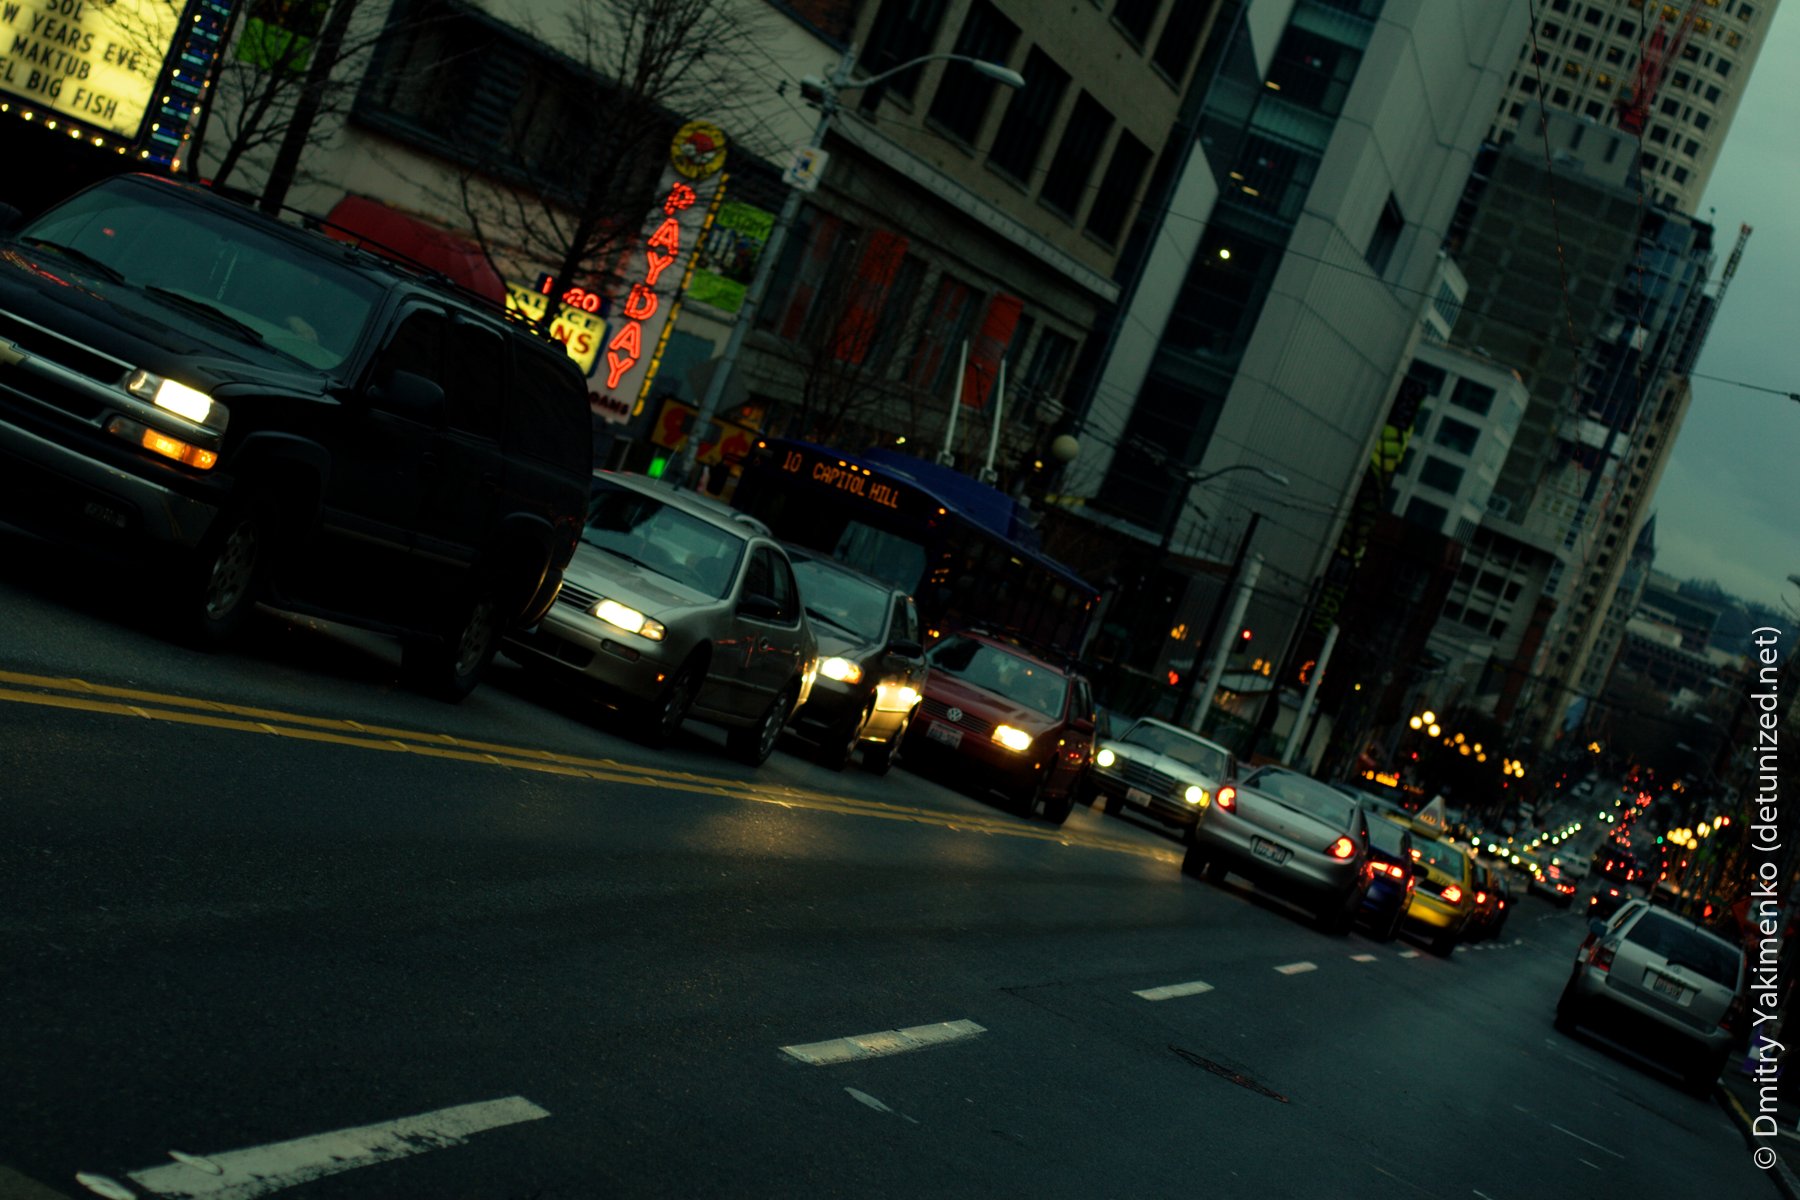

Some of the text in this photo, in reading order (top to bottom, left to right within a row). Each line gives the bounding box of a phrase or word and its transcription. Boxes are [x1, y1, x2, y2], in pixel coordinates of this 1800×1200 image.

[10, 35, 91, 80] MAKTUB
[31, 12, 95, 53] YEARS
[103, 42, 141, 71] EVE
[25, 69, 63, 98] BIG
[73, 87, 119, 121] FISH
[606, 181, 697, 390] PAYDAY
[782, 451, 899, 509] 10 CAPITOL HILL
